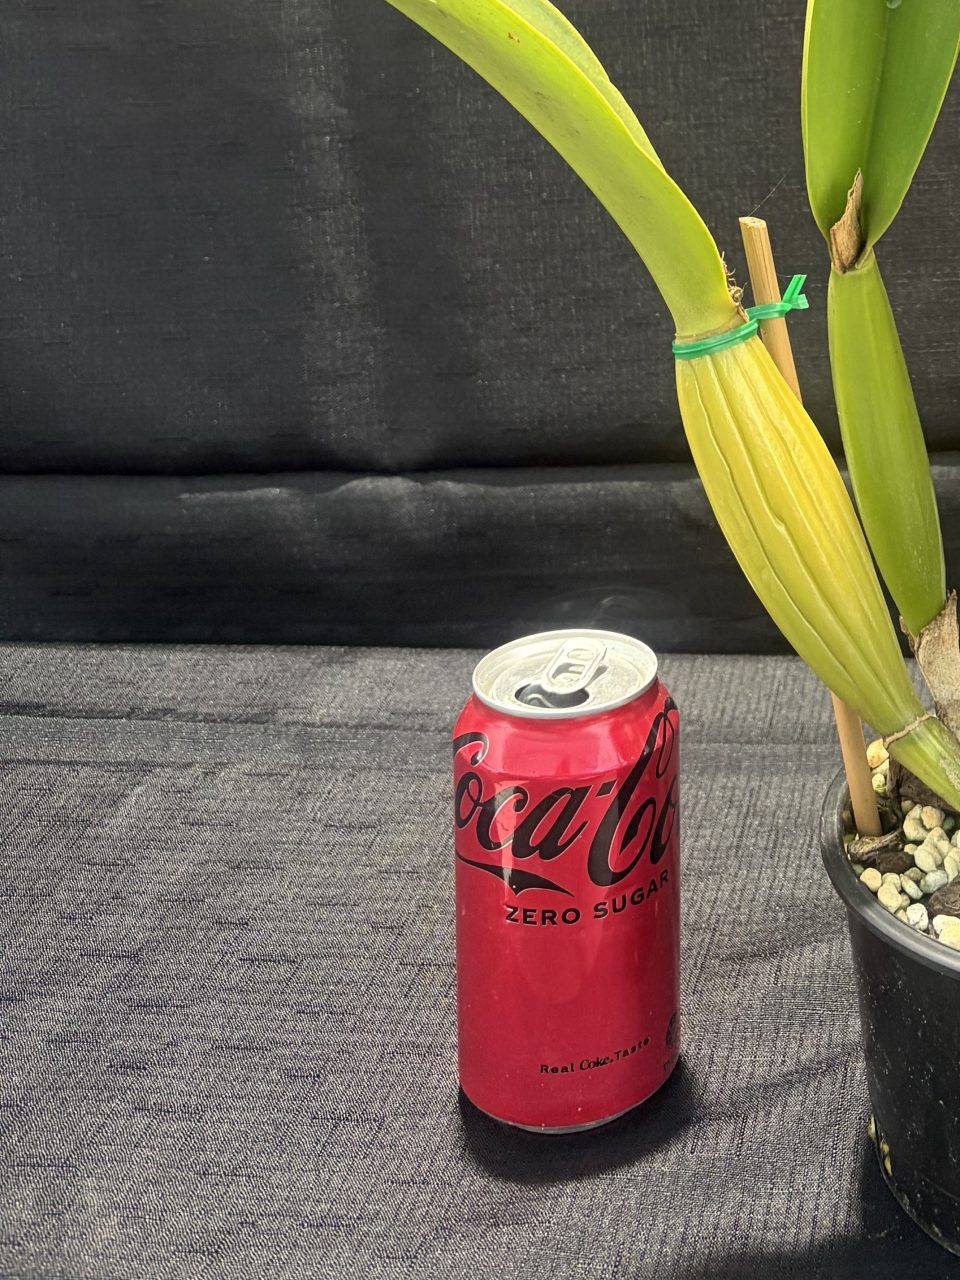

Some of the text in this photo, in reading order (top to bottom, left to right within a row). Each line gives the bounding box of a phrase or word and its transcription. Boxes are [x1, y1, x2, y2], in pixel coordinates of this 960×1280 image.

[505, 868, 670, 926] ZERO SUGAR
[540, 1063, 575, 1074] Real
[614, 1037, 650, 1061] Taste
